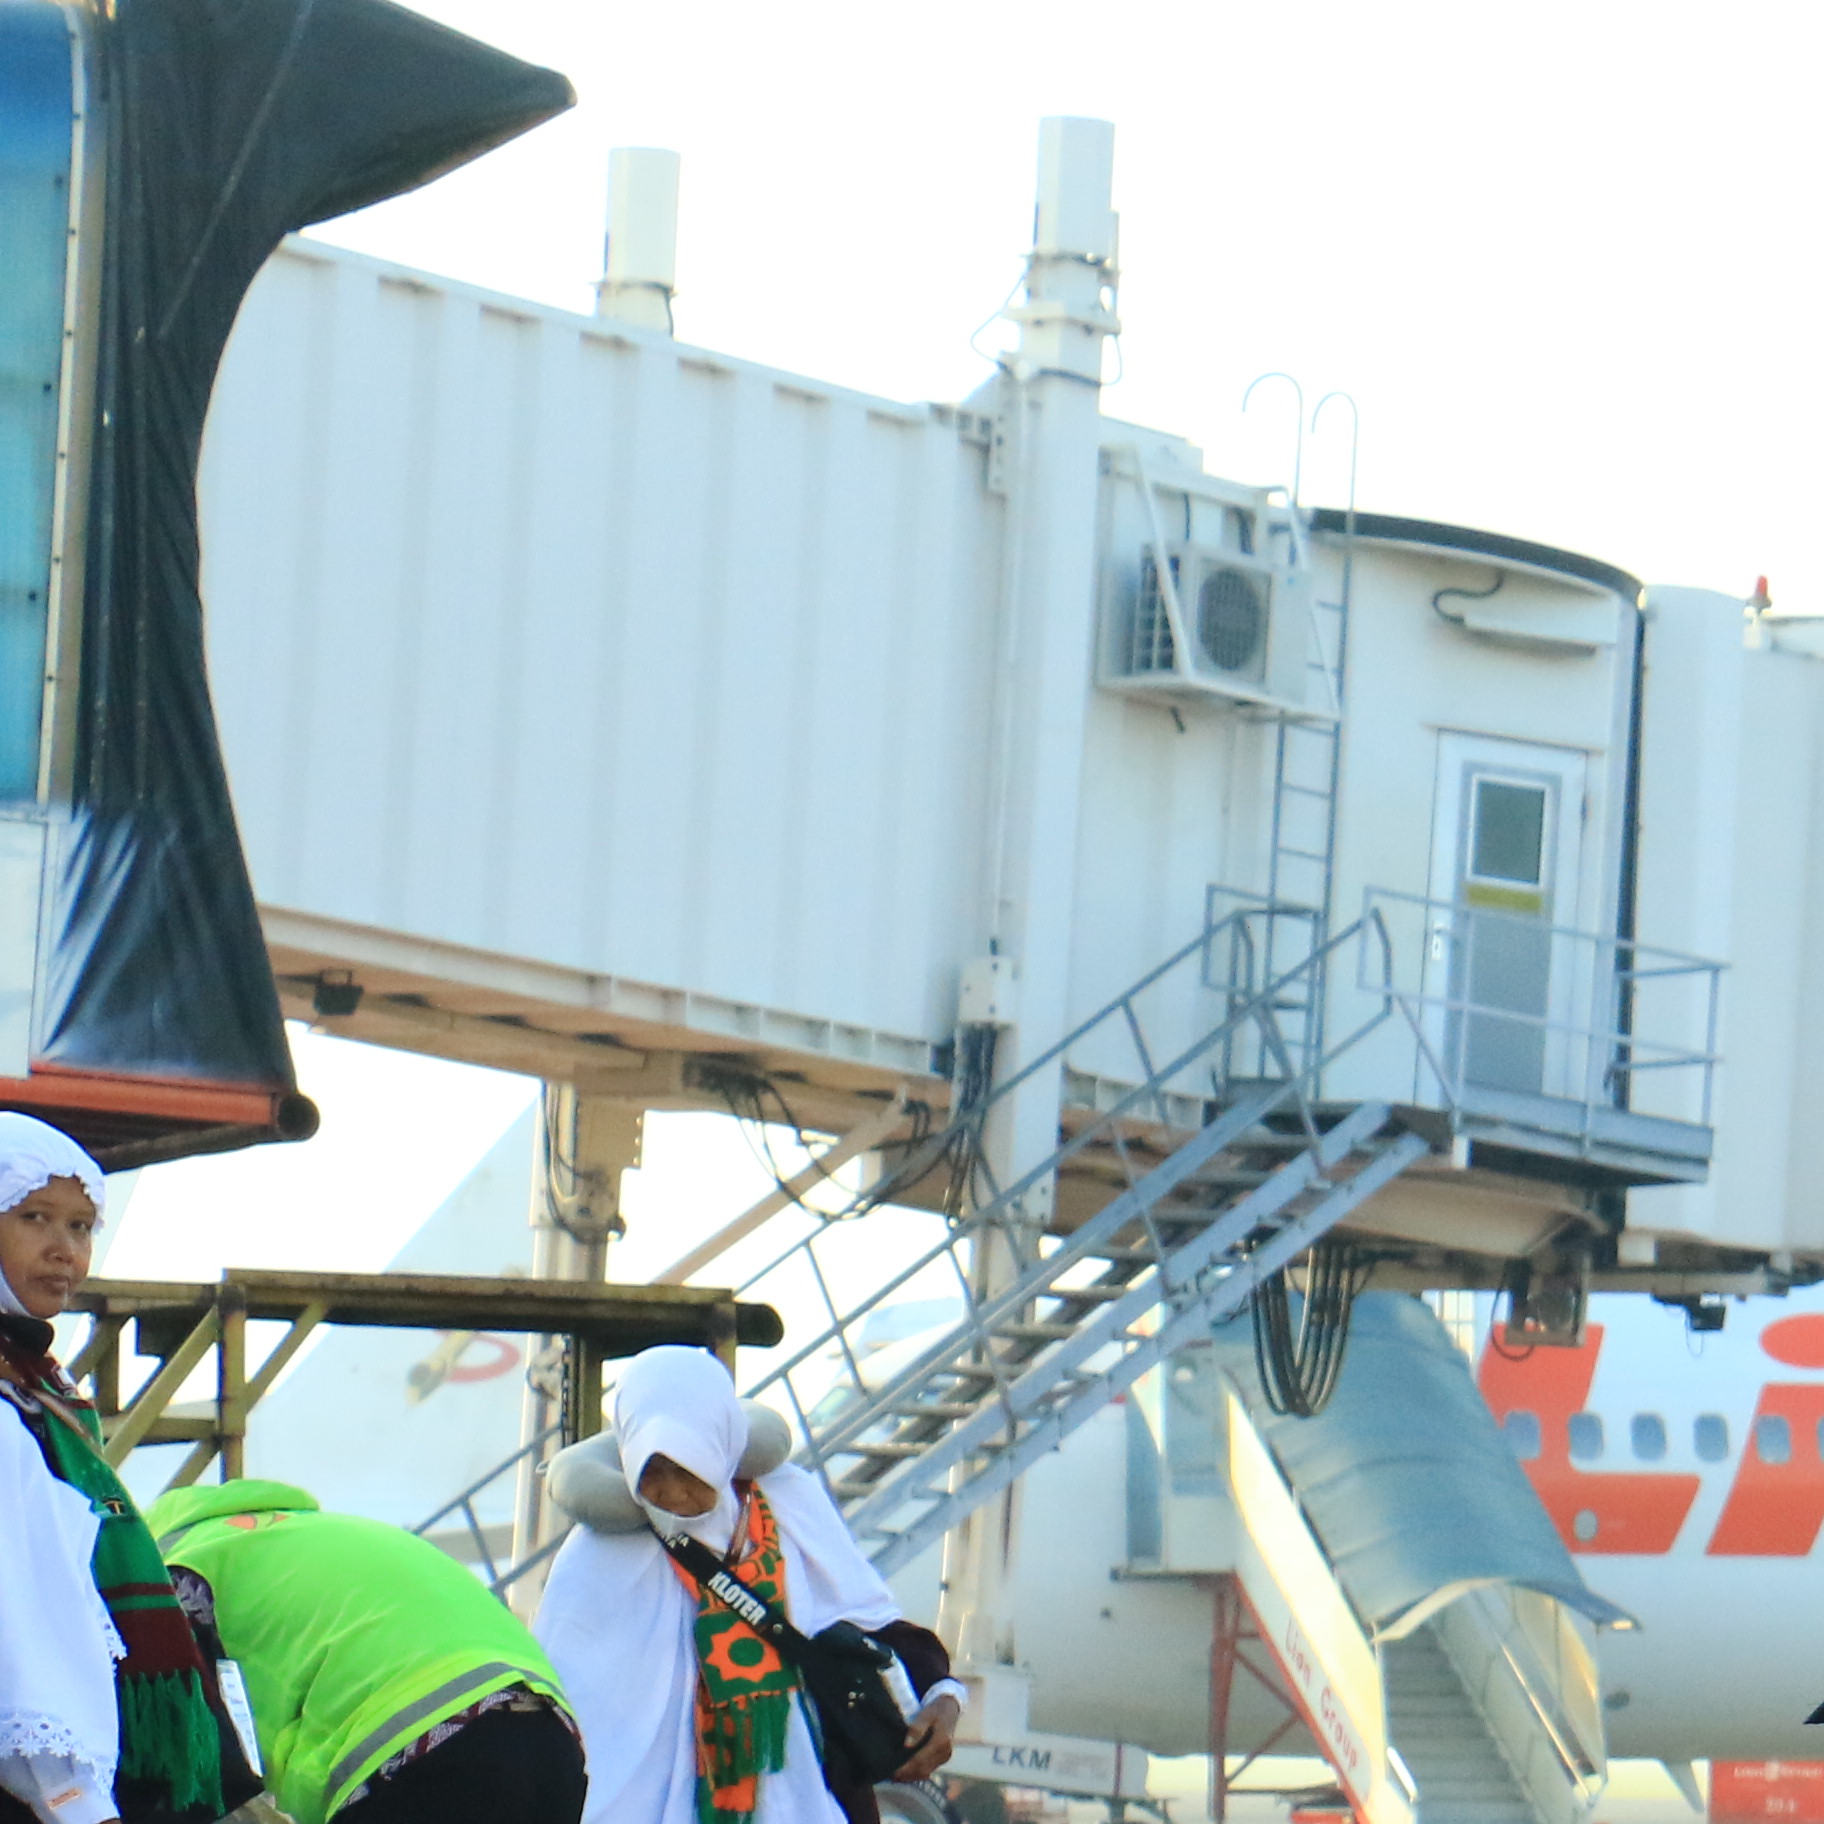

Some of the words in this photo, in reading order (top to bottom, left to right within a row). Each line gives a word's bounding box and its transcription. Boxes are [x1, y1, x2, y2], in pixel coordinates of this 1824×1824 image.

[707, 1571, 767, 1626] KLOTER
[1285, 1617, 1314, 1689] Lion
[1319, 1686, 1358, 1773] Group
[992, 1745, 1052, 1771] LKM
